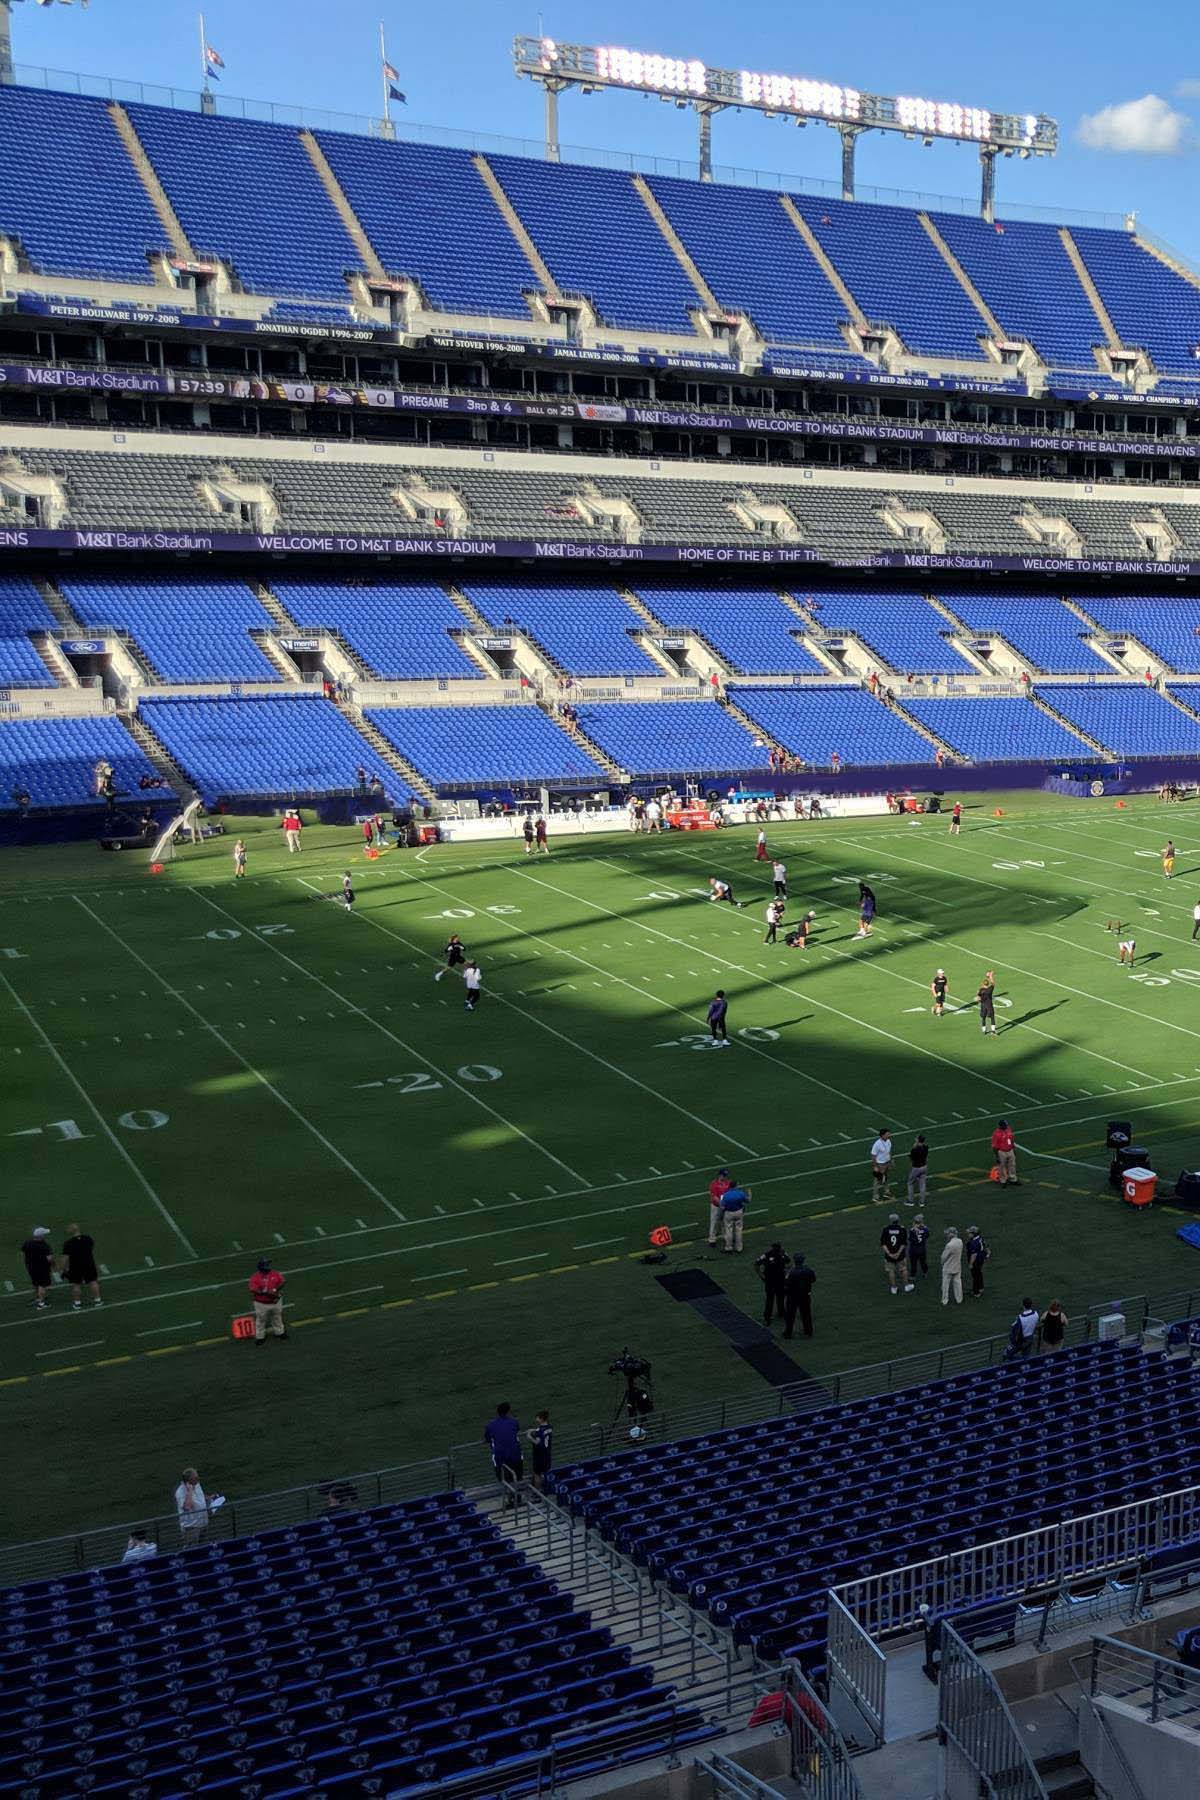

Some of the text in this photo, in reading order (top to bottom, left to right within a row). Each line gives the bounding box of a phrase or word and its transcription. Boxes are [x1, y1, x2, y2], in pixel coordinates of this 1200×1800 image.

[50, 304, 180, 325] PETER BOULWARE 1997-2005
[255, 322, 373, 340] JONATHAN OGDEN 1996-2007
[433, 337, 526, 353] MATT STOVER 1996-2008
[554, 348, 639, 363] JAMAL LEWIS 2000-2006
[702, 361, 736, 371] 1996-2012
[26, 368, 66, 385] M&T
[66, 371, 100, 387] Bank
[102, 374, 159, 391] Stadium
[810, 370, 844, 380] 2001-2010
[896, 377, 929, 387] 2002-2012
[181, 380, 575, 416] 57:39 0 0 PREGAME 3RD & 4 BALL ON 25
[1123, 394, 1144, 402] WORLD
[1146, 396, 1180, 404] CHAMPIONS
[633, 409, 662, 424] M&T
[663, 411, 688, 425] Bank
[690, 413, 732, 428] Stadium
[746, 418, 924, 440] WELCOME TO M&T BANK STADIUM
[936, 430, 1020, 447] M&T Bank Stadium
[1030, 437, 1195, 457] HOME OF THE BALTIMORE RAVENS
[77, 532, 212, 549] M&T Bank Stadium
[258, 537, 496, 554] WELCOME TO M&T BANK STADIUM
[535, 543, 643, 559] M&T Bank Stadium
[678, 548, 760, 562] HOME OF THE
[904, 554, 993, 569] M&T Bank Stadium
[1023, 559, 1190, 574] WELCOME TO M&T BANK STADIUM
[293, 639, 318, 648] merritt
[487, 639, 511, 647] merritt
[441, 904, 522, 919] 30
[206, 923, 295, 942] 20
[387, 1064, 503, 1094] 20
[44, 1109, 171, 1142] 10
[1126, 1182, 1136, 1197] G
[656, 1228, 670, 1244] 20
[890, 1235, 897, 1247] 9
[237, 1319, 252, 1336] 10
